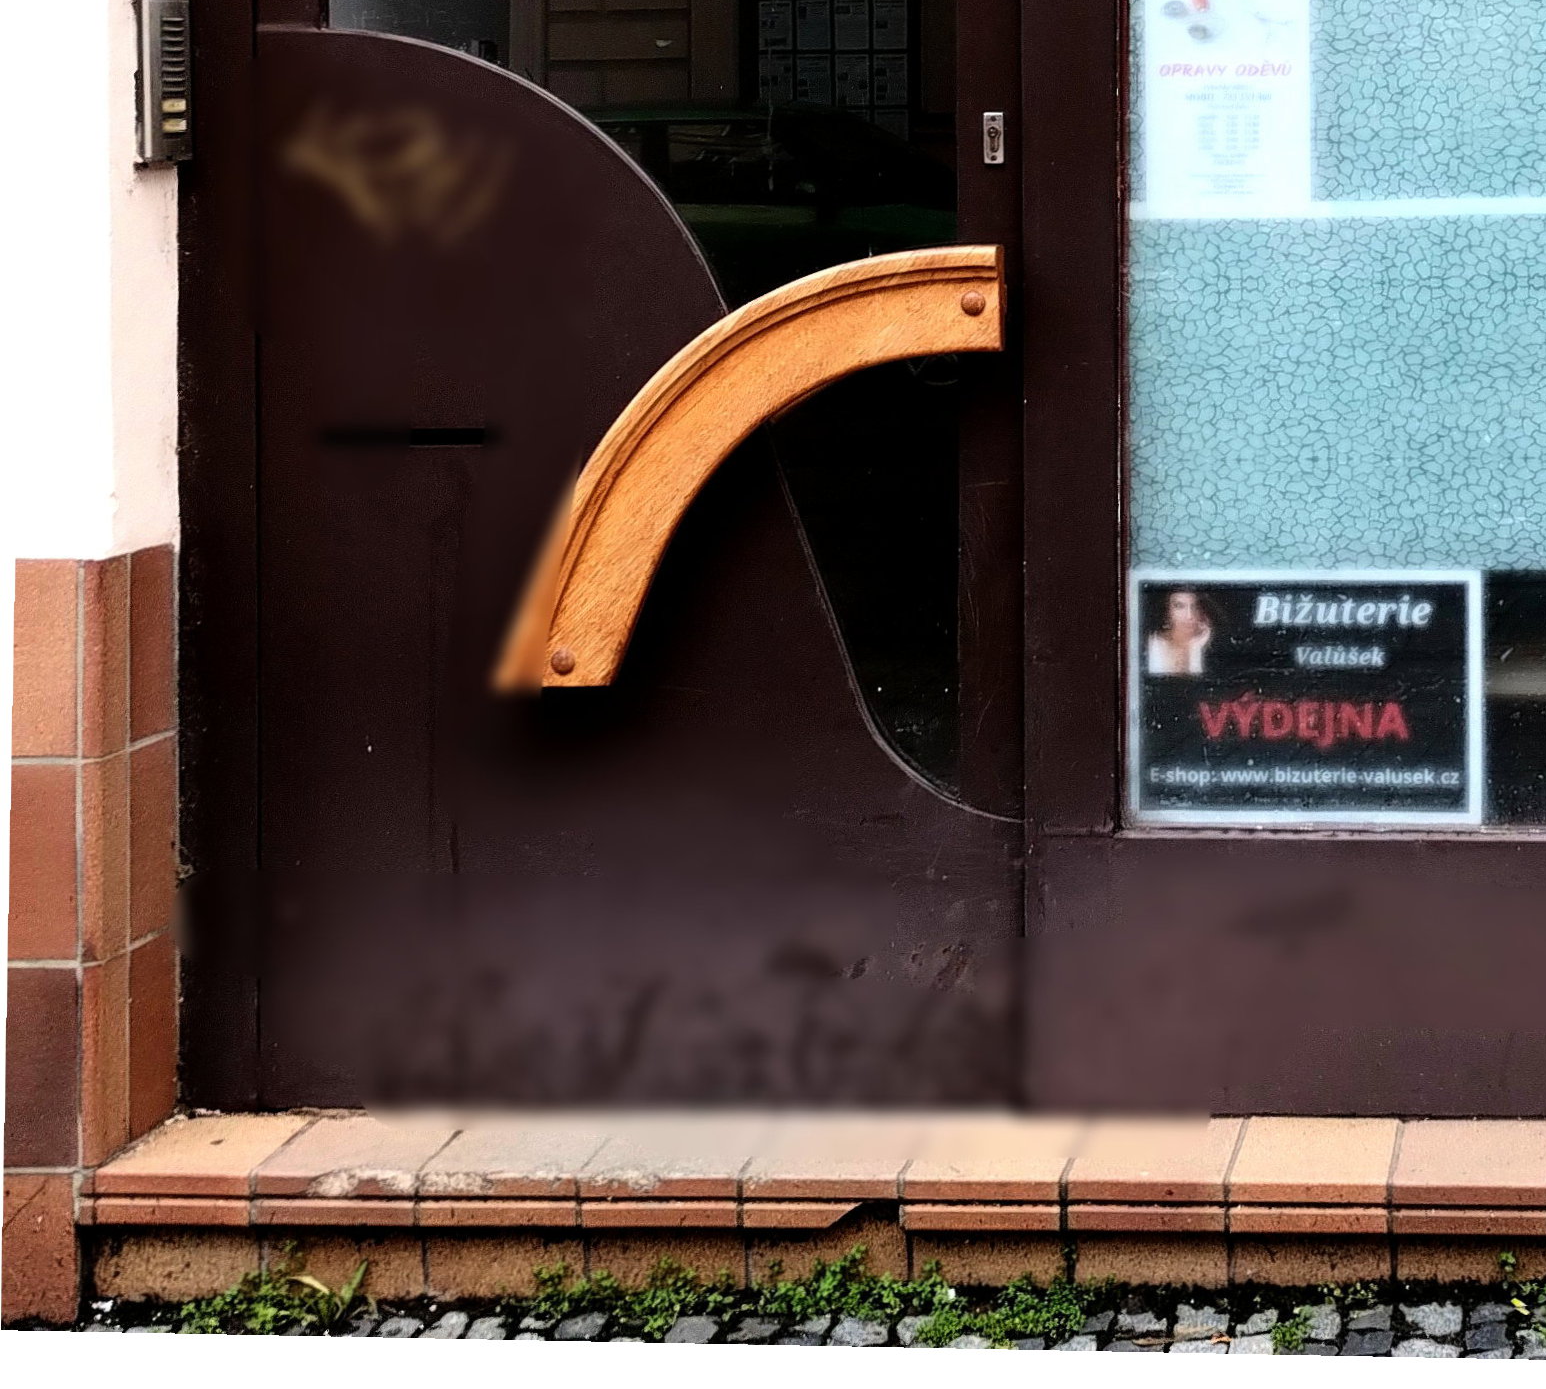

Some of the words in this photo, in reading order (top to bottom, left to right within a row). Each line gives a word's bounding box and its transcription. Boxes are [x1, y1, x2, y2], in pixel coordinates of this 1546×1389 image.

[1159, 63, 1227, 77] OPRAVY
[1254, 594, 1433, 626] Bižuterie
[1295, 644, 1387, 668] Valůšek
[1199, 690, 1412, 749] VÝDEJNA
[1150, 766, 1217, 787] E-shop:
[1220, 766, 1460, 785] www.bizuterie-valusek.cz
